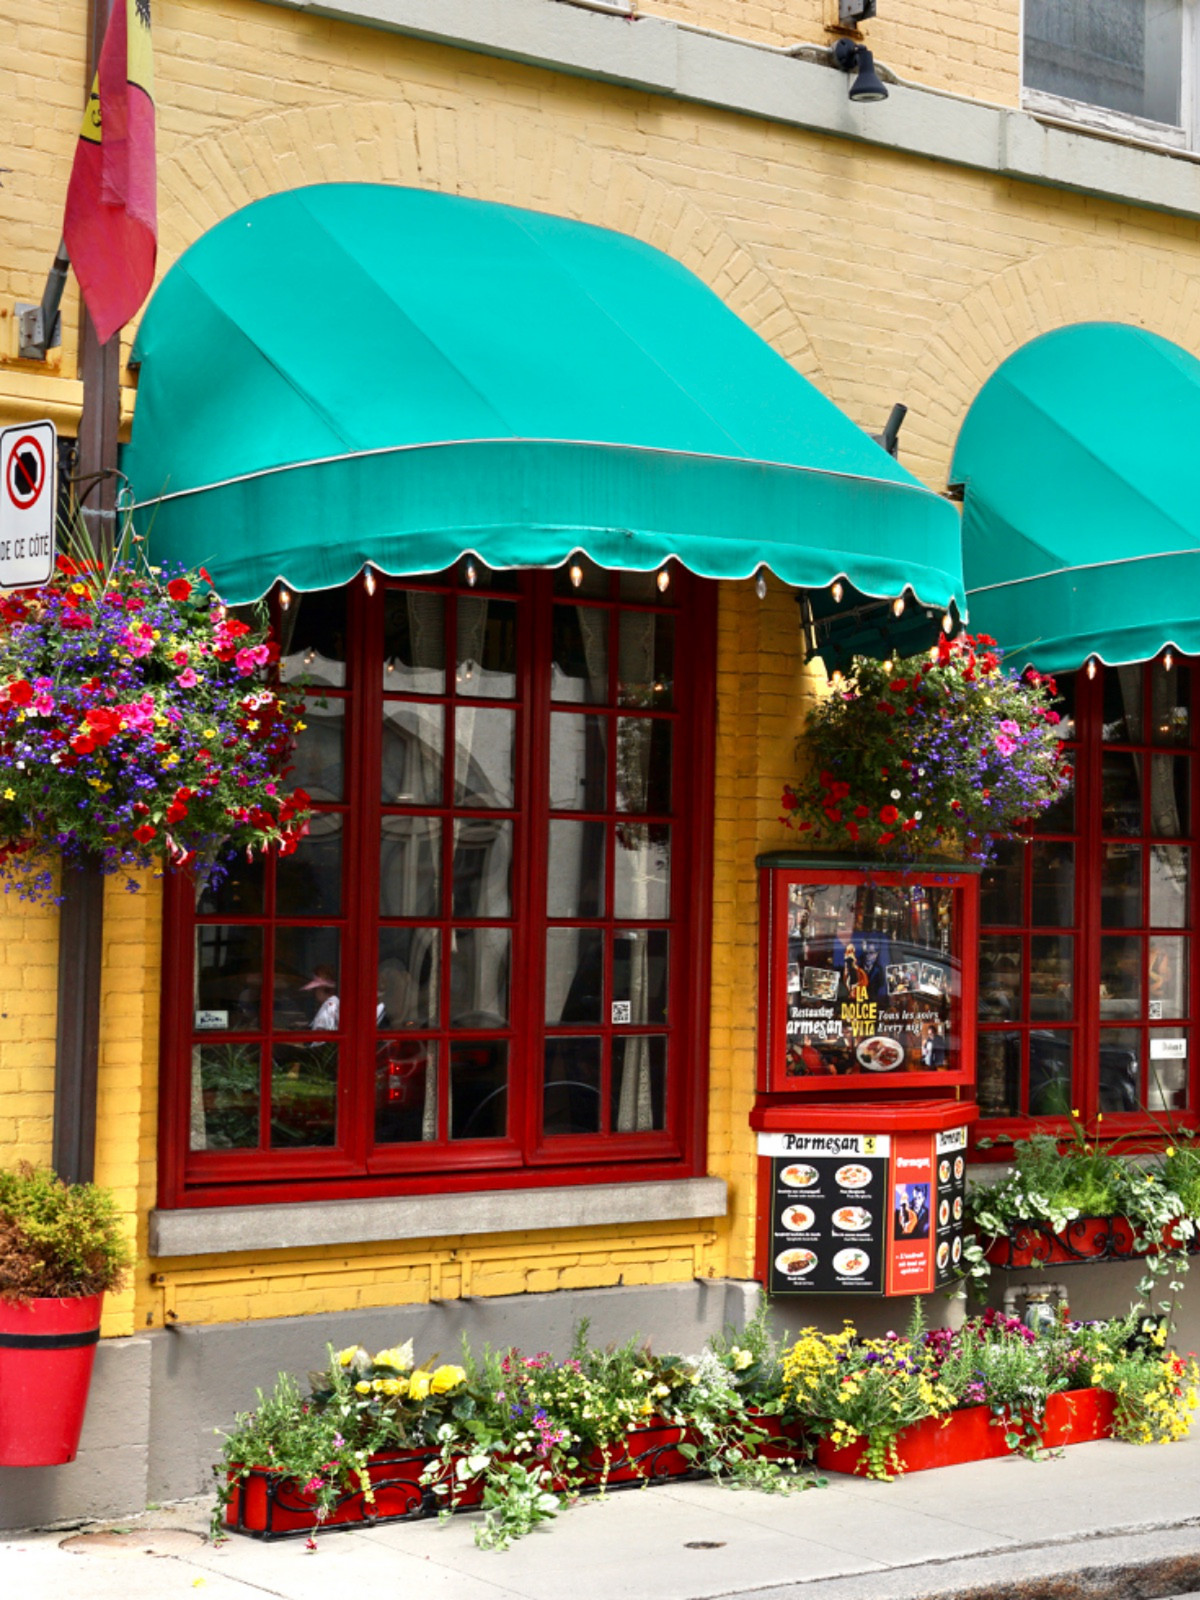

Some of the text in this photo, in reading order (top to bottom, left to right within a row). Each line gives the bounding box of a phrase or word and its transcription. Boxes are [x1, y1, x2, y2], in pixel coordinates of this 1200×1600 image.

[14, 538, 25, 559] CE
[29, 532, 50, 557] CÔTÉ
[856, 985, 869, 1003] LA
[841, 1002, 877, 1020] DOLCE
[878, 1010, 900, 1021] Tous
[902, 1010, 915, 1020] les
[786, 1019, 844, 1039] armesan
[851, 1020, 876, 1037] VITA
[783, 1133, 859, 1155] Parmesan
